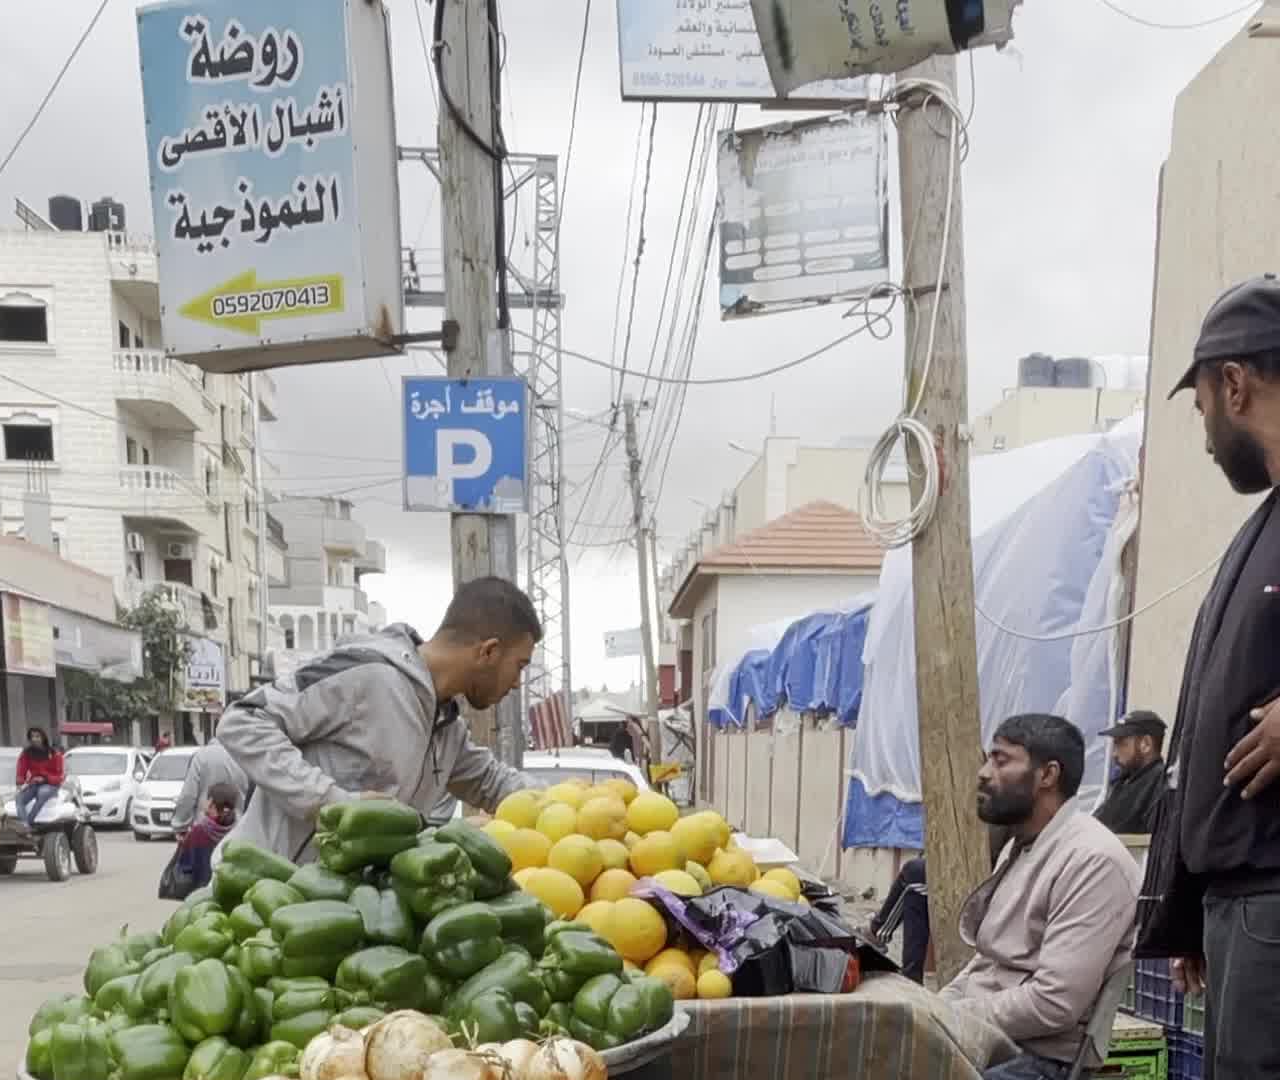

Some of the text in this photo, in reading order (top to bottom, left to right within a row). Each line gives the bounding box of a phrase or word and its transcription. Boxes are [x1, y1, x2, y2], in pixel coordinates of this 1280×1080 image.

[183, 18, 299, 85] روضة
[161, 89, 345, 166] أشبال الأقصى
[168, 178, 340, 254] النموذجية
[212, 286, 330, 318] 0592070413
[410, 384, 520, 420] موقف أجرة
[436, 428, 492, 505] P
